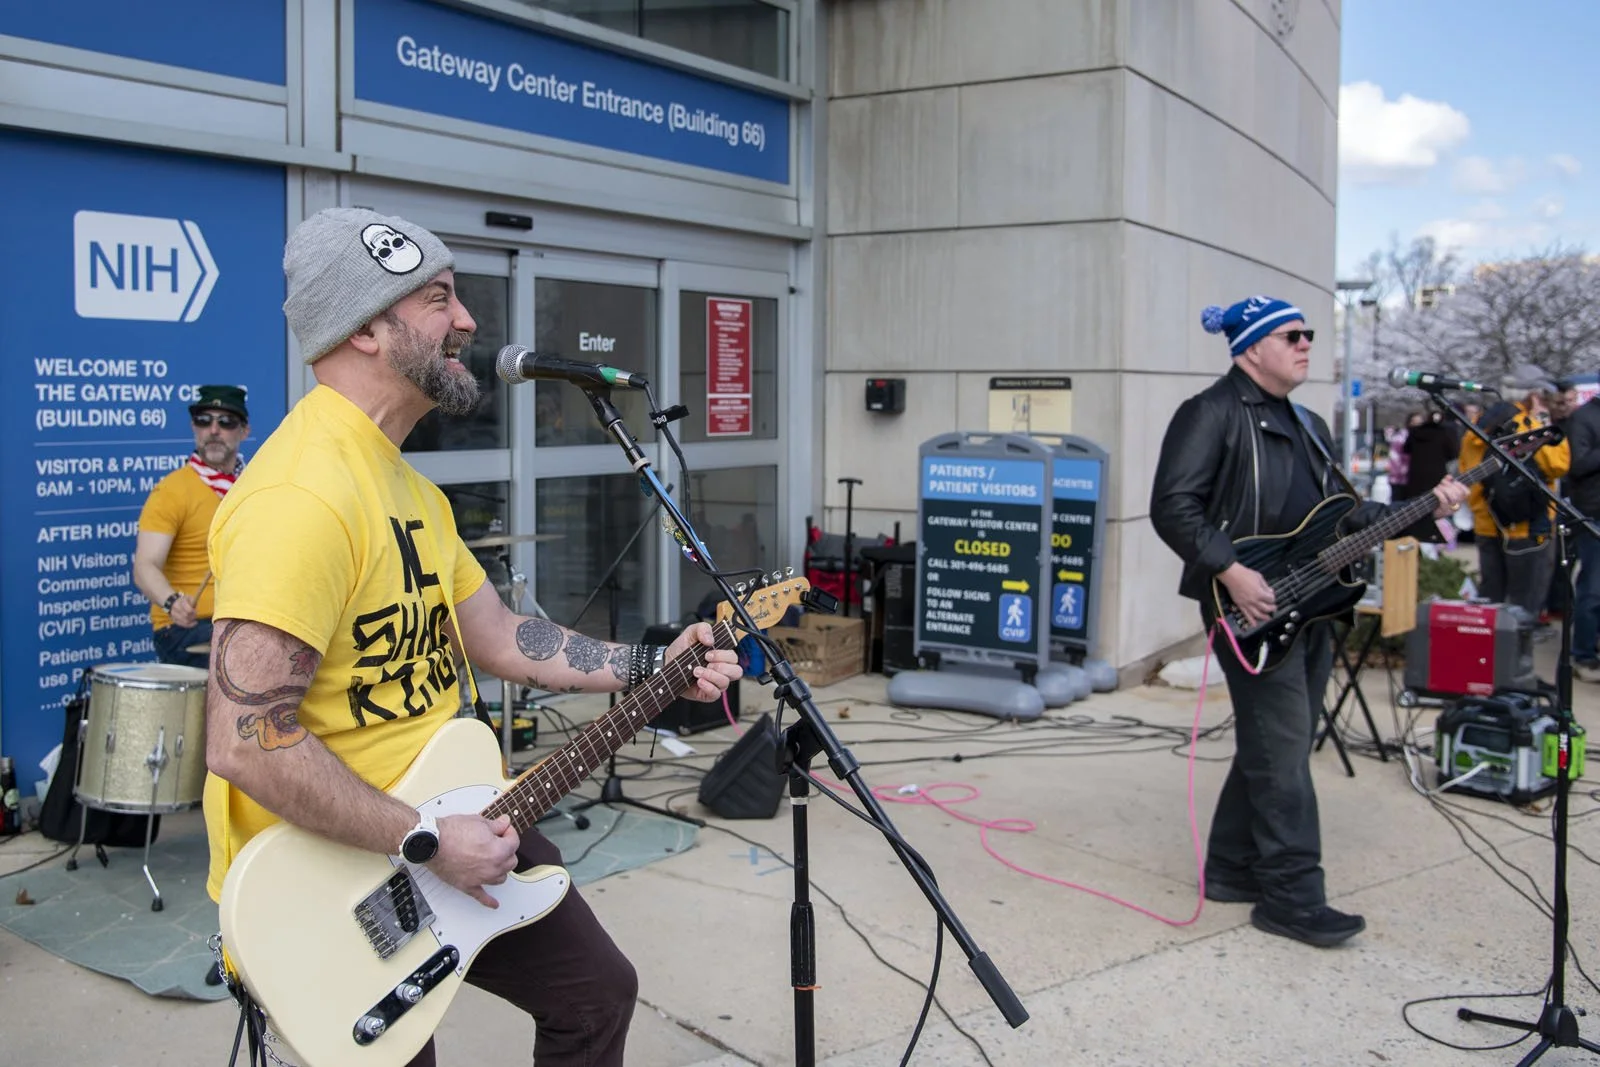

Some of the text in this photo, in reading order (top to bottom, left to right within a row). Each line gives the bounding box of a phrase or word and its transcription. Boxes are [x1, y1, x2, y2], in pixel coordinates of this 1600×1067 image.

[396, 36, 765, 152] Gateway Center Entrance (Building 66)
[89, 241, 180, 293] NIH
[579, 331, 616, 353] Enter
[35, 358, 168, 378] WELCOME TO
[35, 384, 76, 402] THE
[81, 384, 174, 402] GATEWAY
[36, 408, 167, 431] (BUILDING 66)
[36, 458, 103, 475] VISITOR
[108, 457, 119, 472] &
[929, 464, 996, 481] PATIENTS /
[37, 480, 73, 497] 6AM
[88, 478, 135, 495] 10PM,
[929, 480, 1037, 498] PATIENT VISITORS
[1052, 477, 1094, 490] ACIENTES
[971, 508, 993, 518] IF THE
[1059, 512, 1092, 525] CENTER
[927, 515, 1039, 532] GATEWAY VISITOR CENTER
[37, 525, 93, 543] AFTER
[954, 538, 1012, 557] CLOSED
[38, 555, 67, 573] NIH
[71, 552, 128, 569] Visitors
[927, 557, 949, 570] CALL
[38, 571, 130, 594] Commercial
[926, 572, 940, 582] OR
[926, 586, 991, 602] FOLLOW SIGNS
[39, 594, 118, 616] Inspection
[926, 598, 953, 610] TO AN
[926, 610, 976, 624] ALTERNATE
[39, 618, 86, 640] (CVIF)
[926, 621, 972, 635] ENTRANCE
[1002, 626, 1026, 638] CVIF
[40, 645, 103, 667] Patients
[106, 642, 118, 657] &
[40, 673, 69, 688] use
